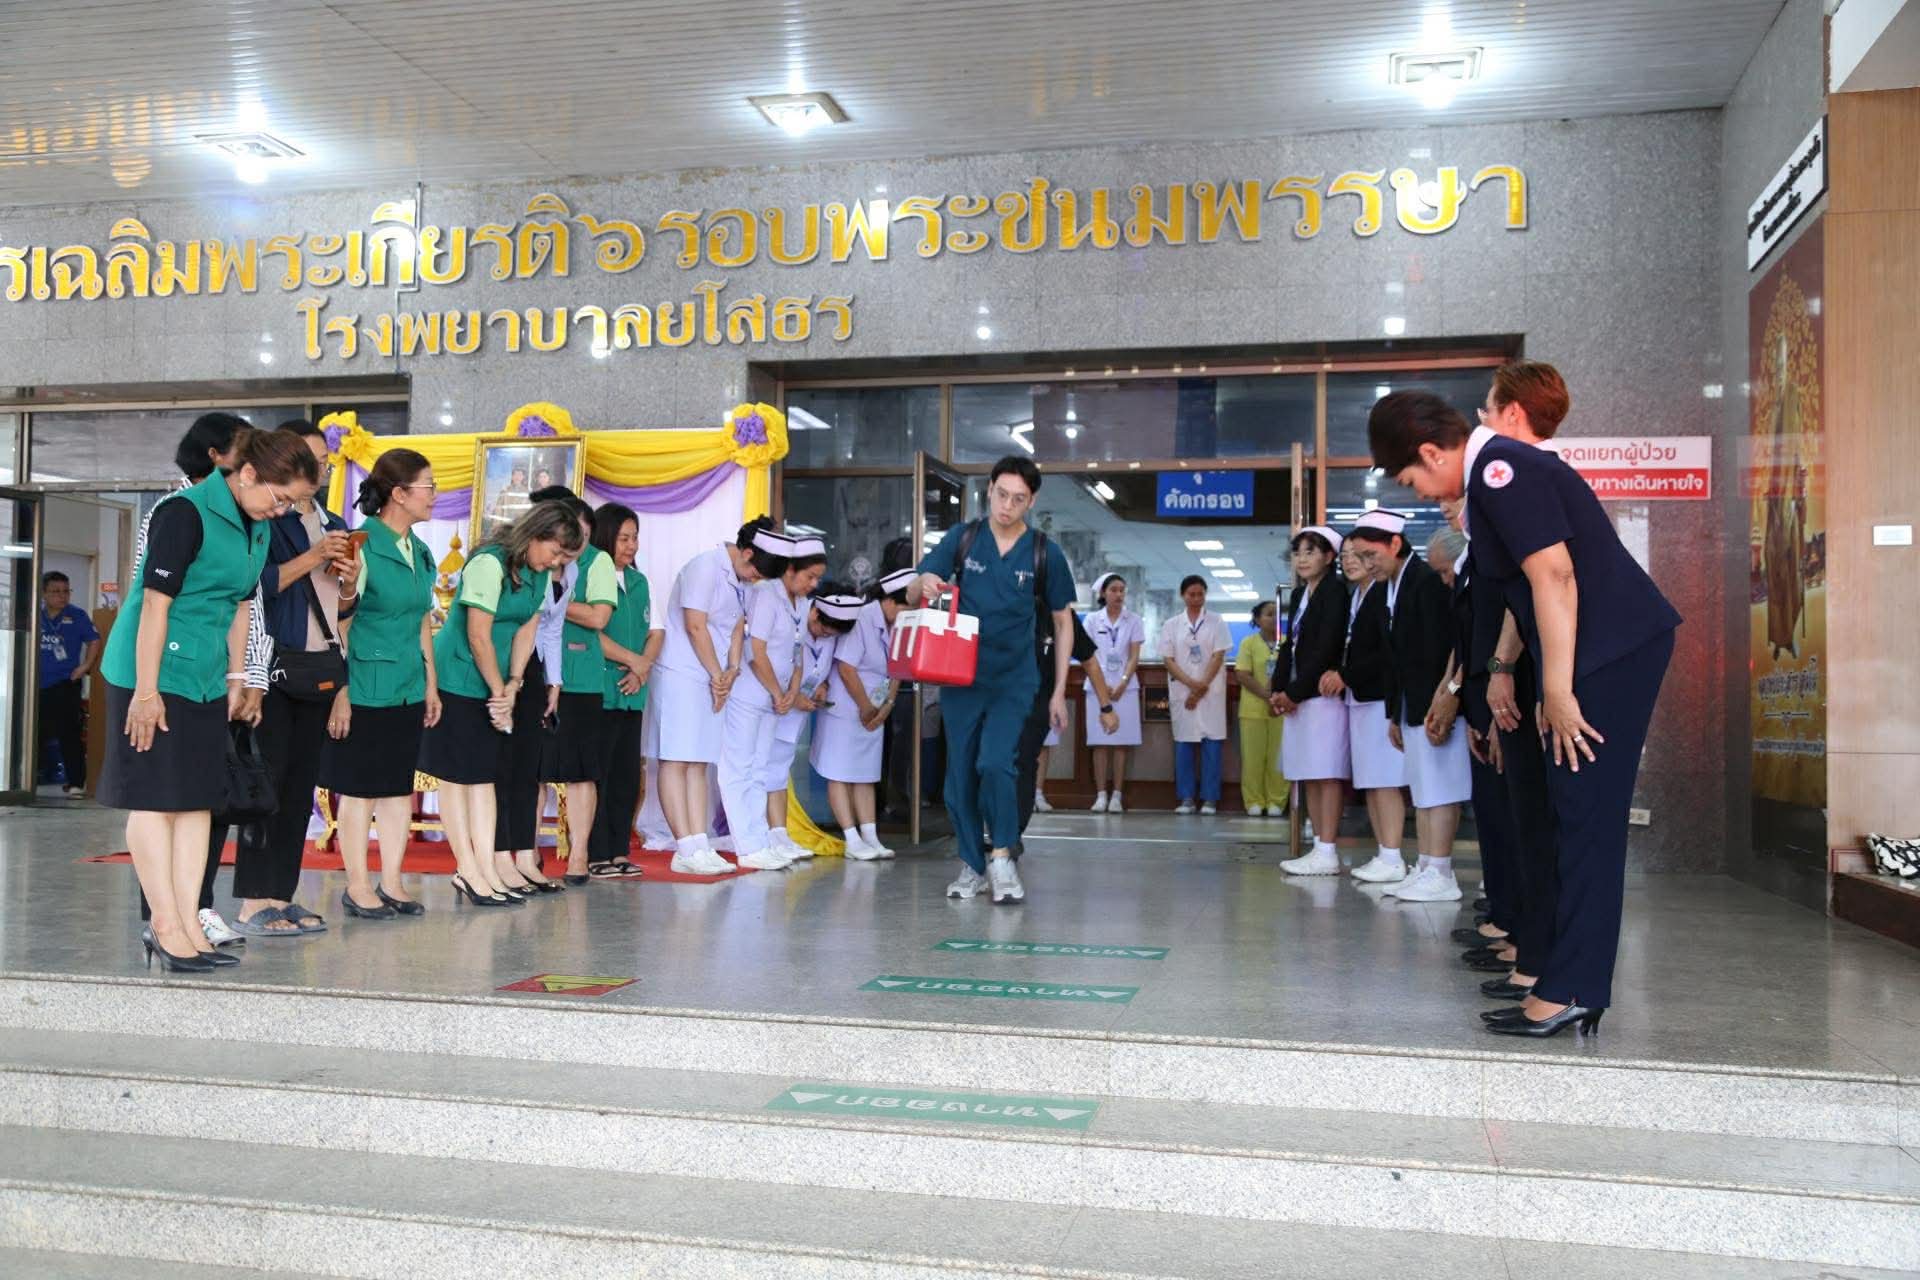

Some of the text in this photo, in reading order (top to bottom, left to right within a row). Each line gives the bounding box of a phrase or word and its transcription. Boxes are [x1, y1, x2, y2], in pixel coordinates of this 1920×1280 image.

[297, 276, 854, 360] โรงพยาบาลยโสธร
[1561, 442, 1677, 466] จดแยกผู้ป่วย
[1164, 488, 1245, 509] คัดกรอง
[835, 1095, 1039, 1117] ทางออก
